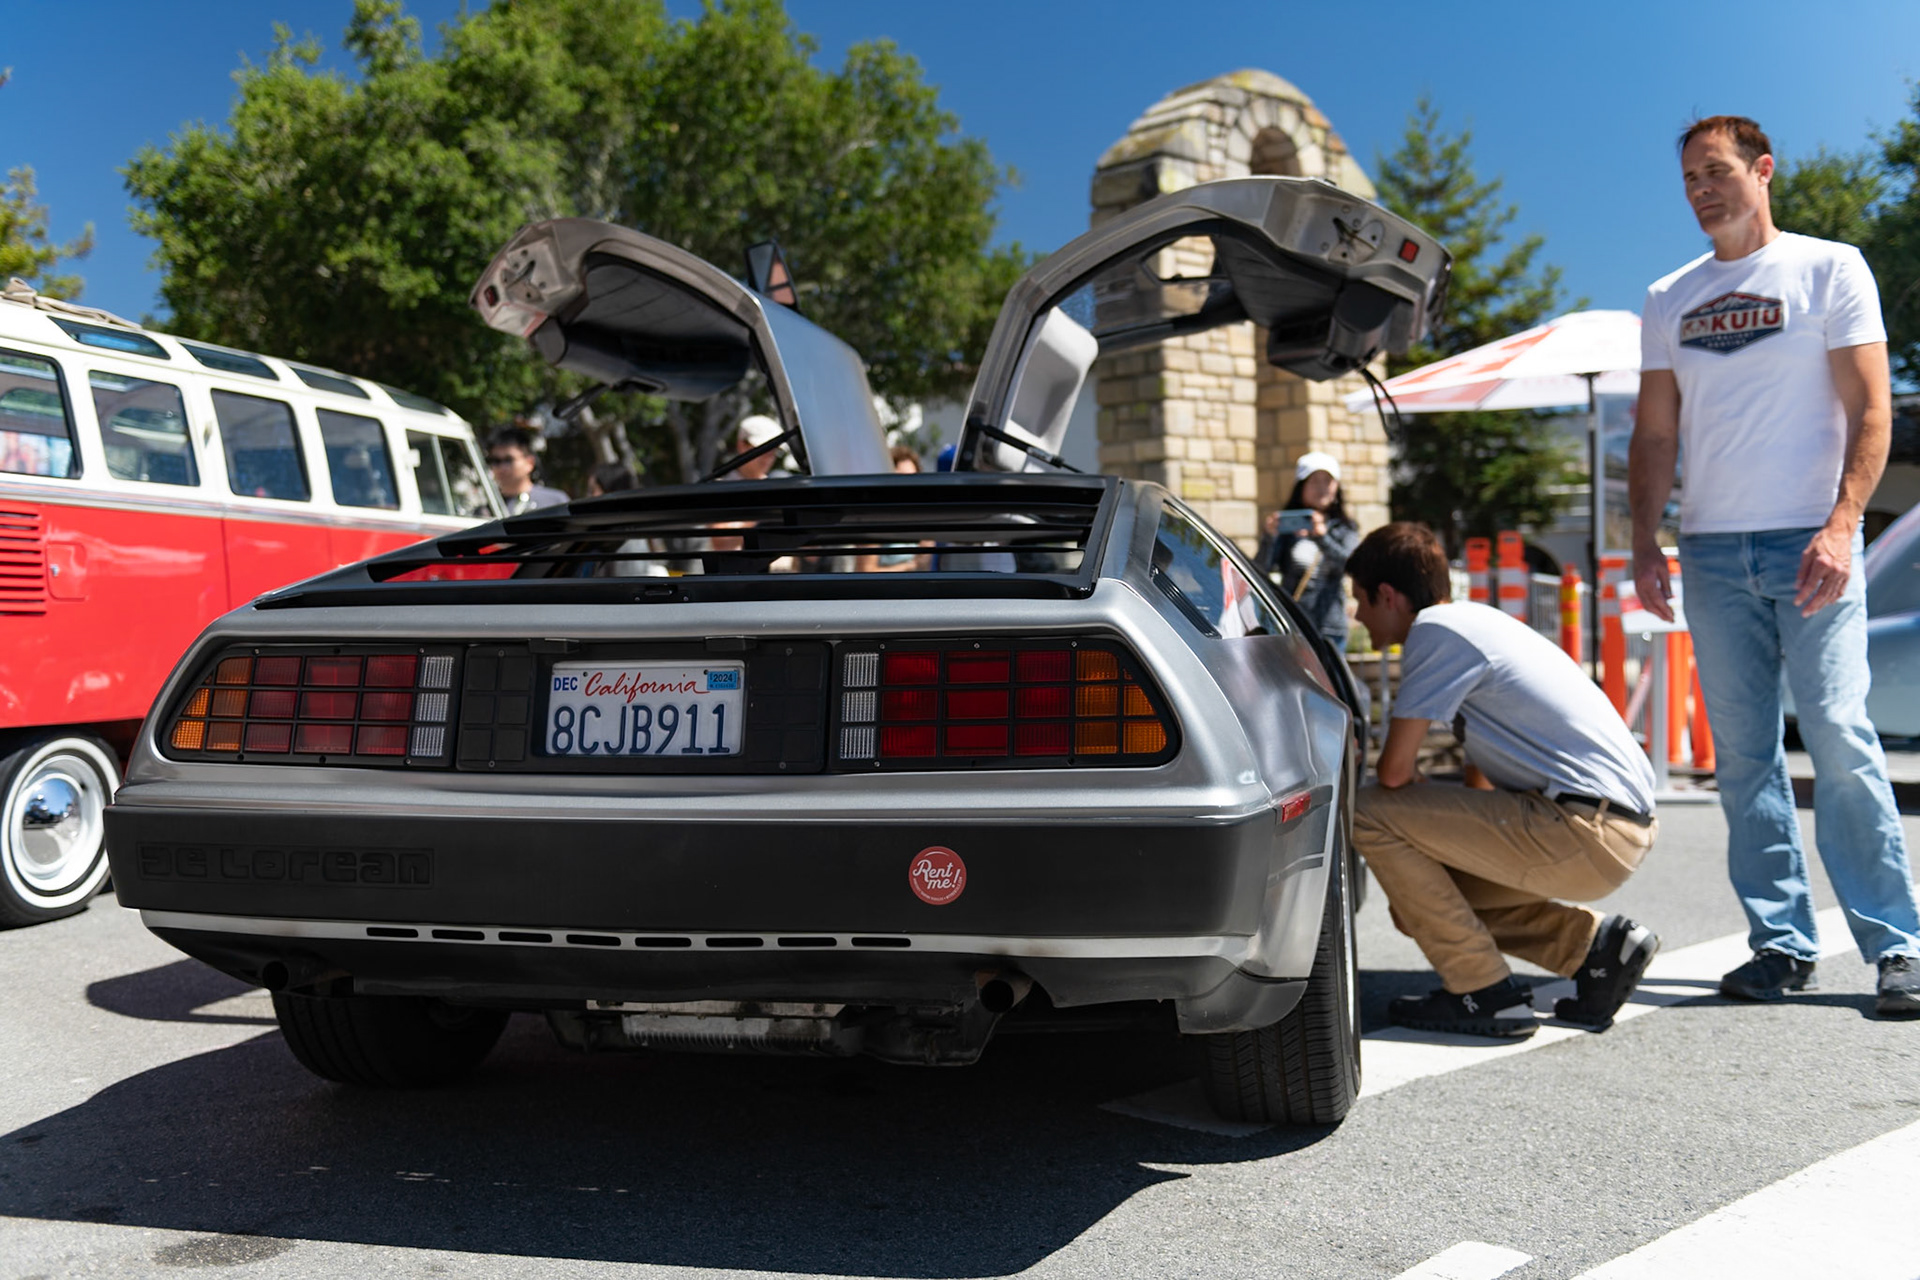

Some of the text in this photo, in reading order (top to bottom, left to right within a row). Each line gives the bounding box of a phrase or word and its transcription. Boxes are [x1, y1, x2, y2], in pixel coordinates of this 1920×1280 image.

[1711, 308, 1781, 332] KUIU
[553, 677, 578, 691] DEC
[584, 672, 710, 704] California
[713, 673, 733, 683] 2024
[552, 703, 730, 754] 8CJB911
[912, 859, 953, 882] Rent
[927, 868, 961, 889] me!
